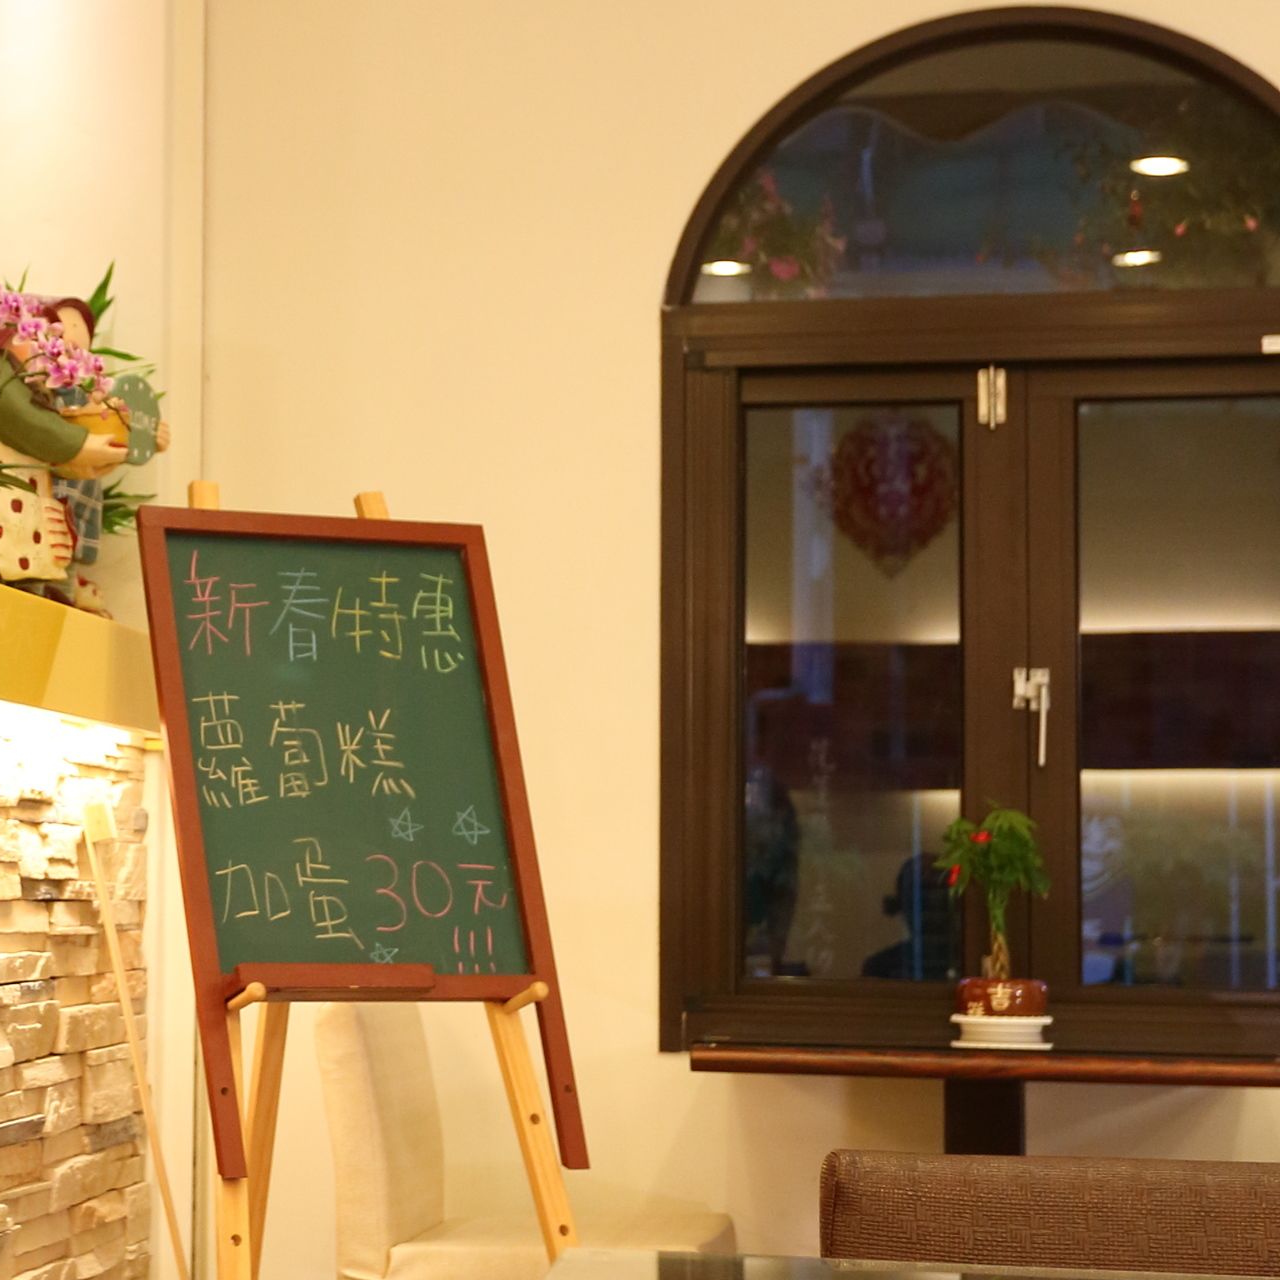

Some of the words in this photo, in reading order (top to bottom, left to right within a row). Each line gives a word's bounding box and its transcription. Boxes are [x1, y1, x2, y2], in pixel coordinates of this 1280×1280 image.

[183, 549, 464, 674] 新春特惠
[191, 690, 417, 809] 蘿蔔糕
